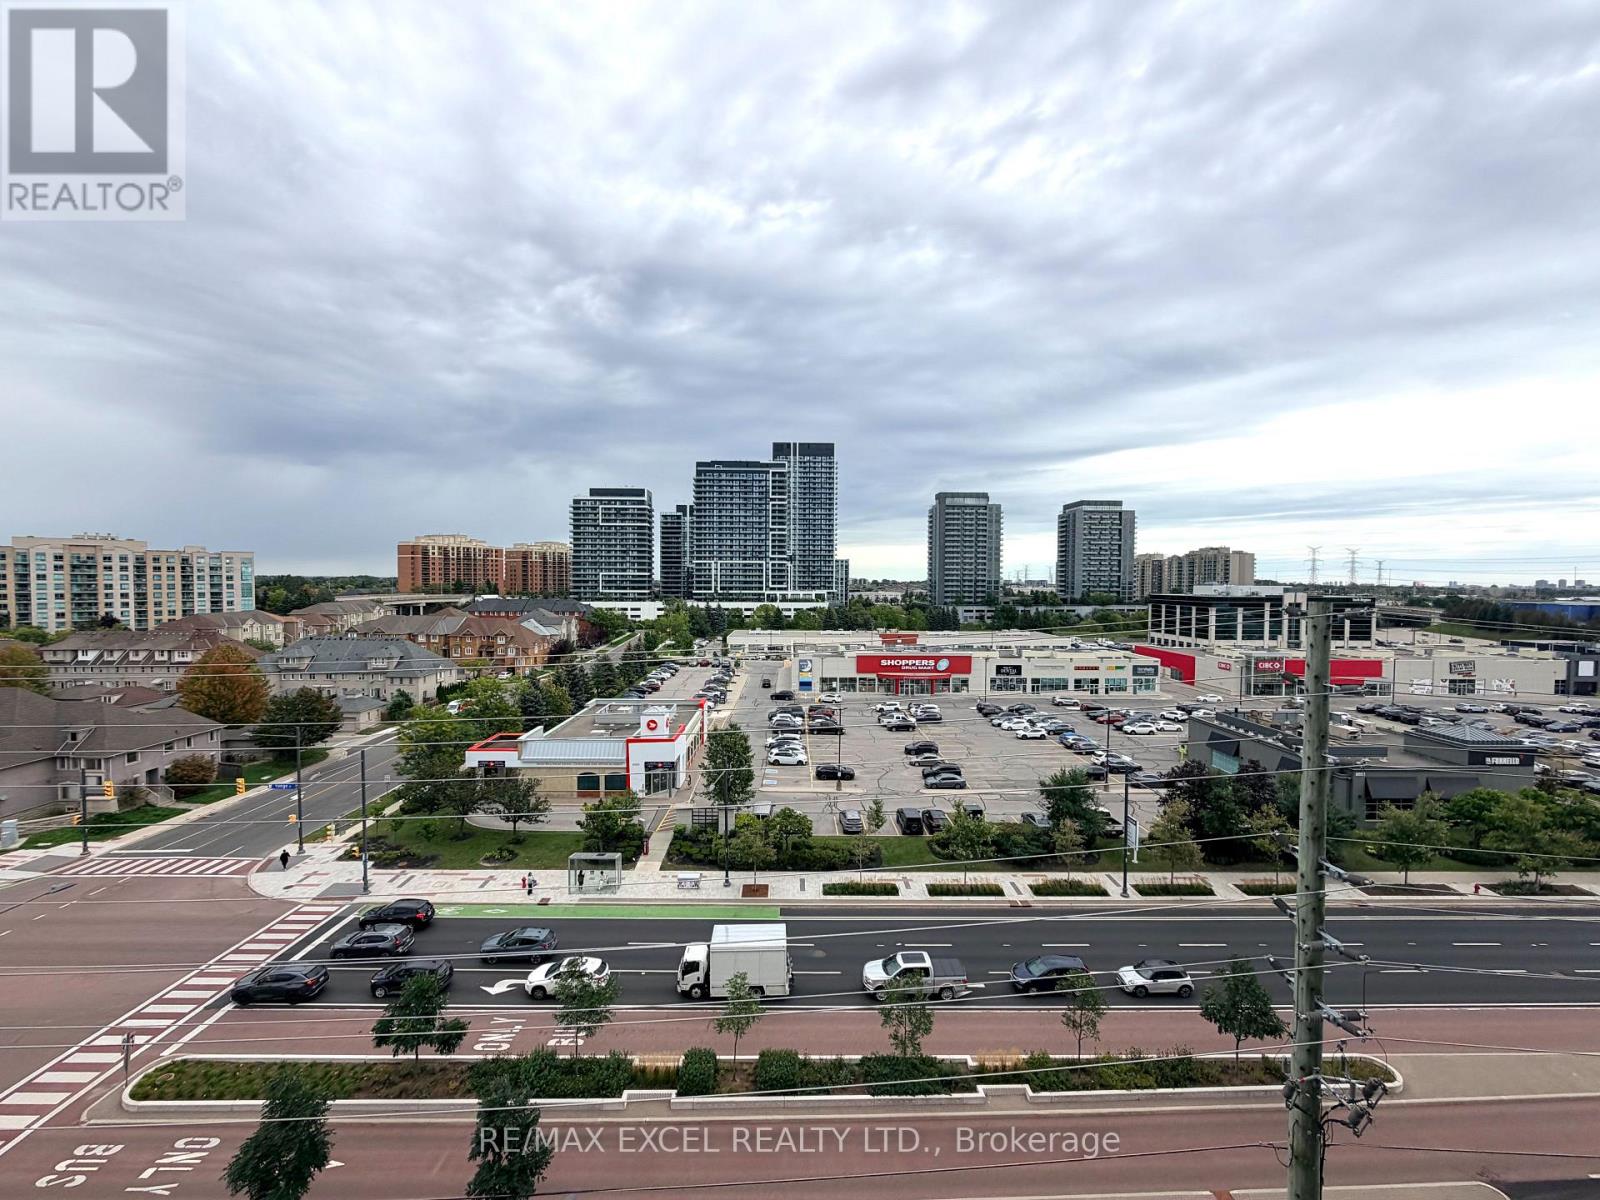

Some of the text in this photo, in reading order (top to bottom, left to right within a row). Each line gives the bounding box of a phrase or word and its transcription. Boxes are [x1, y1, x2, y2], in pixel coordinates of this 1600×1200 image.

[473, 1016, 527, 1051] ONLY
[34, 1144, 126, 1188] BUS
[124, 1137, 221, 1196] ONLY
